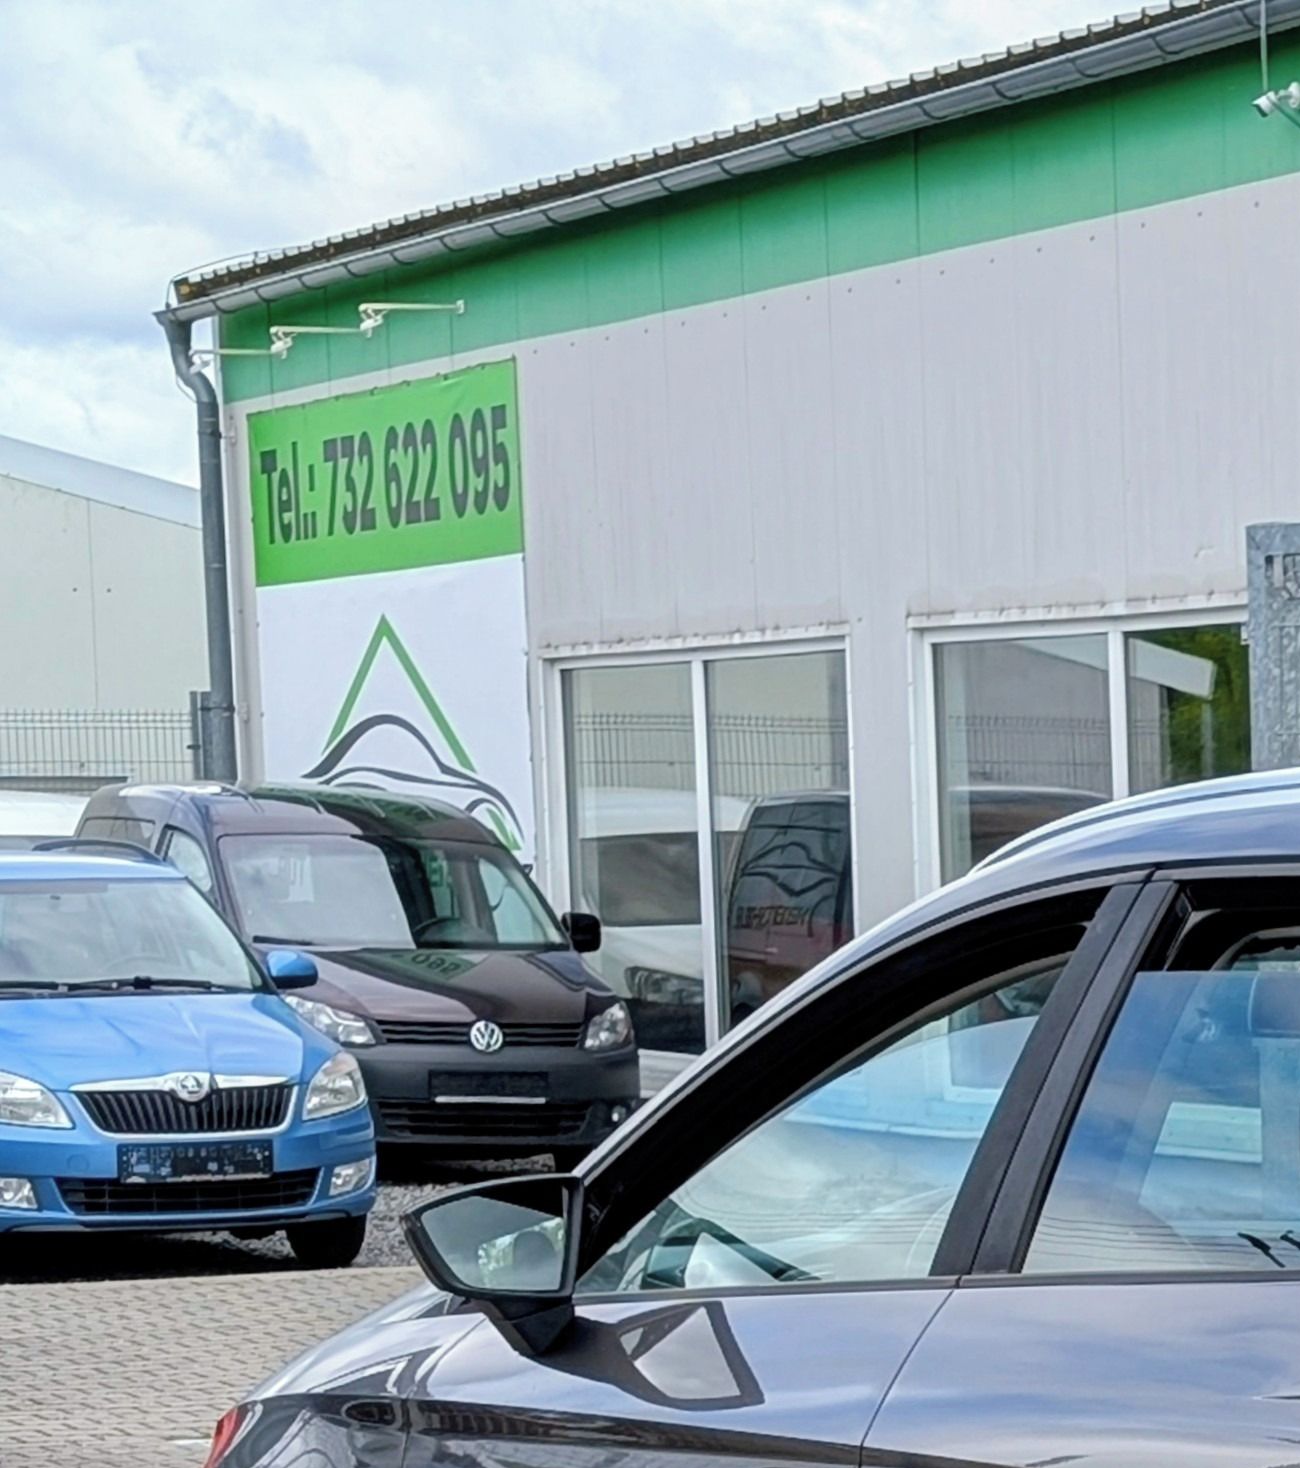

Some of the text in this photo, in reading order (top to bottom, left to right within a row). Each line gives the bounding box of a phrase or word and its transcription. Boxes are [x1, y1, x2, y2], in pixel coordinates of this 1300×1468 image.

[260, 403, 510, 545] Tel.: 732 622 095
